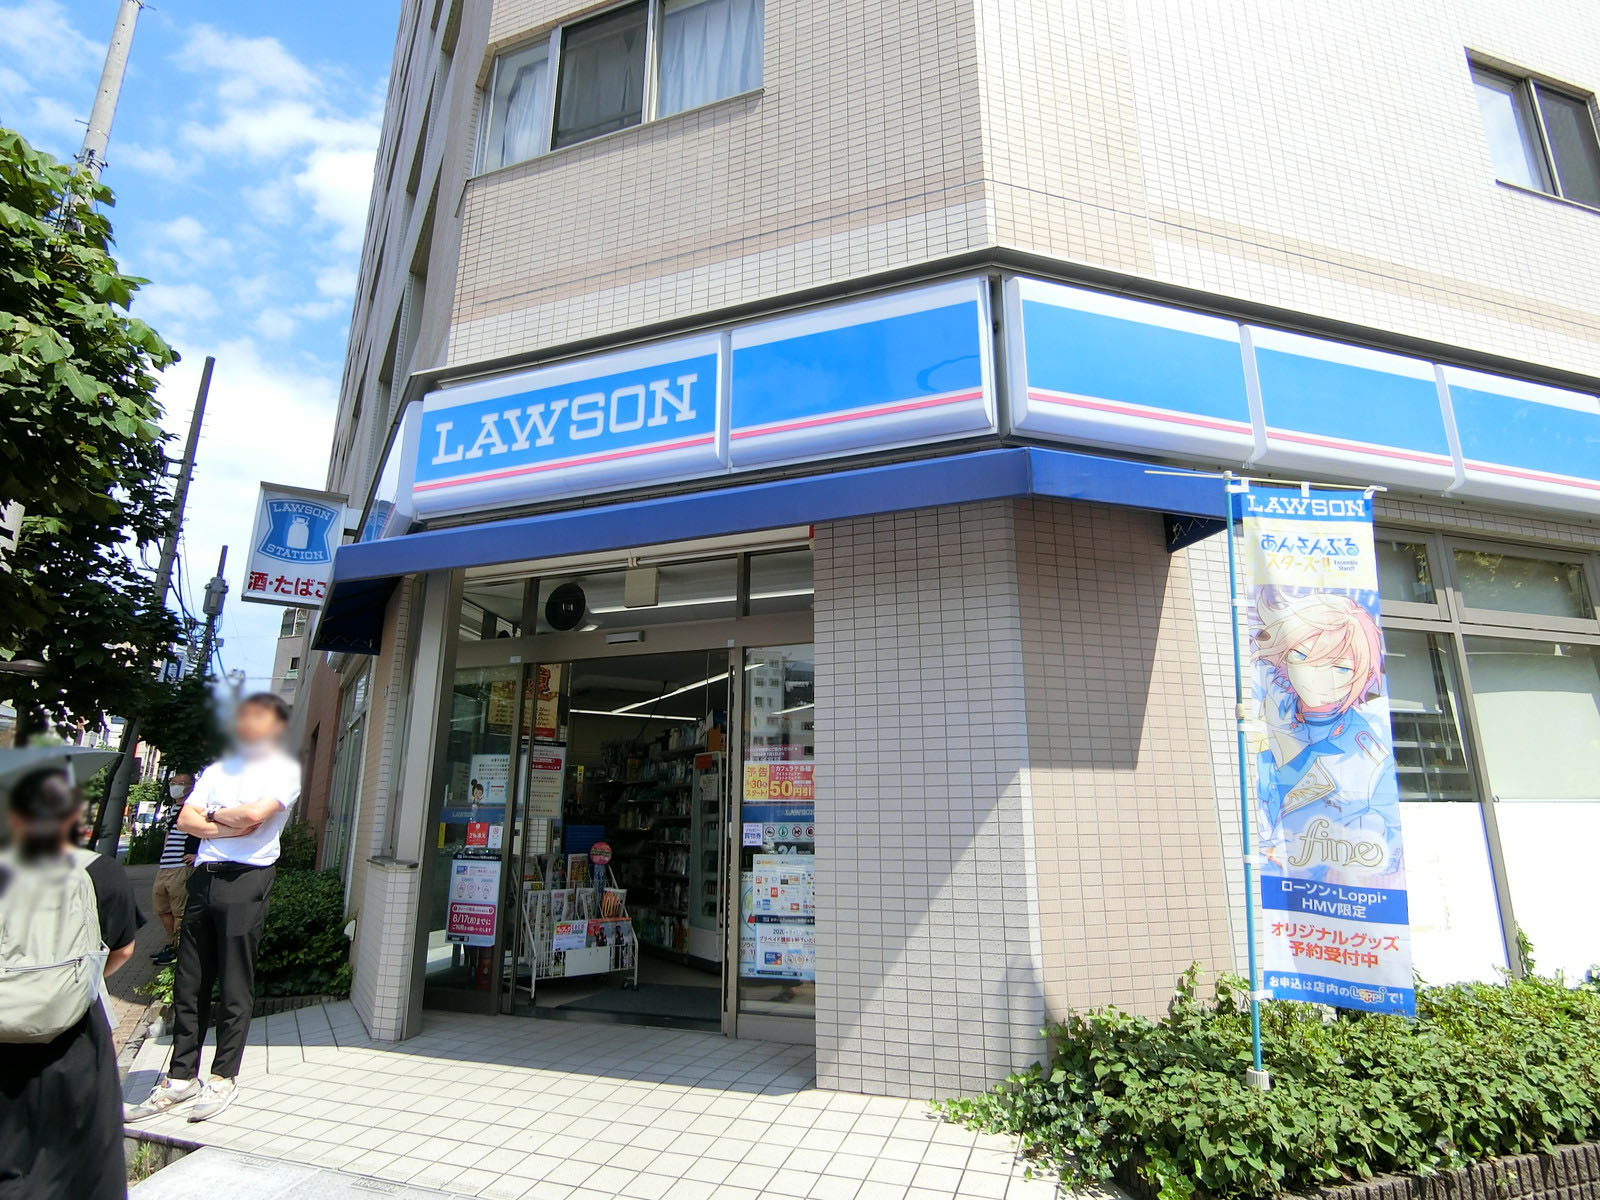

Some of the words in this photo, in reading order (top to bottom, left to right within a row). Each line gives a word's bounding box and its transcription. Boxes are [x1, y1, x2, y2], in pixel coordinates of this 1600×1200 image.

[432, 373, 698, 465] LAWSON
[273, 503, 331, 521] LAWSON
[1247, 495, 1366, 516] LAWSON
[267, 543, 324, 560] STATION
[1261, 534, 1359, 556] あんさんぶる
[1288, 819, 1384, 867] fine
[1302, 897, 1367, 919] HMV限定
[1271, 922, 1400, 951] オリジナルグッズ
[1289, 940, 1379, 969] 予約受付中
[1269, 975, 1404, 1005] お申込は店内のLoppiで!
